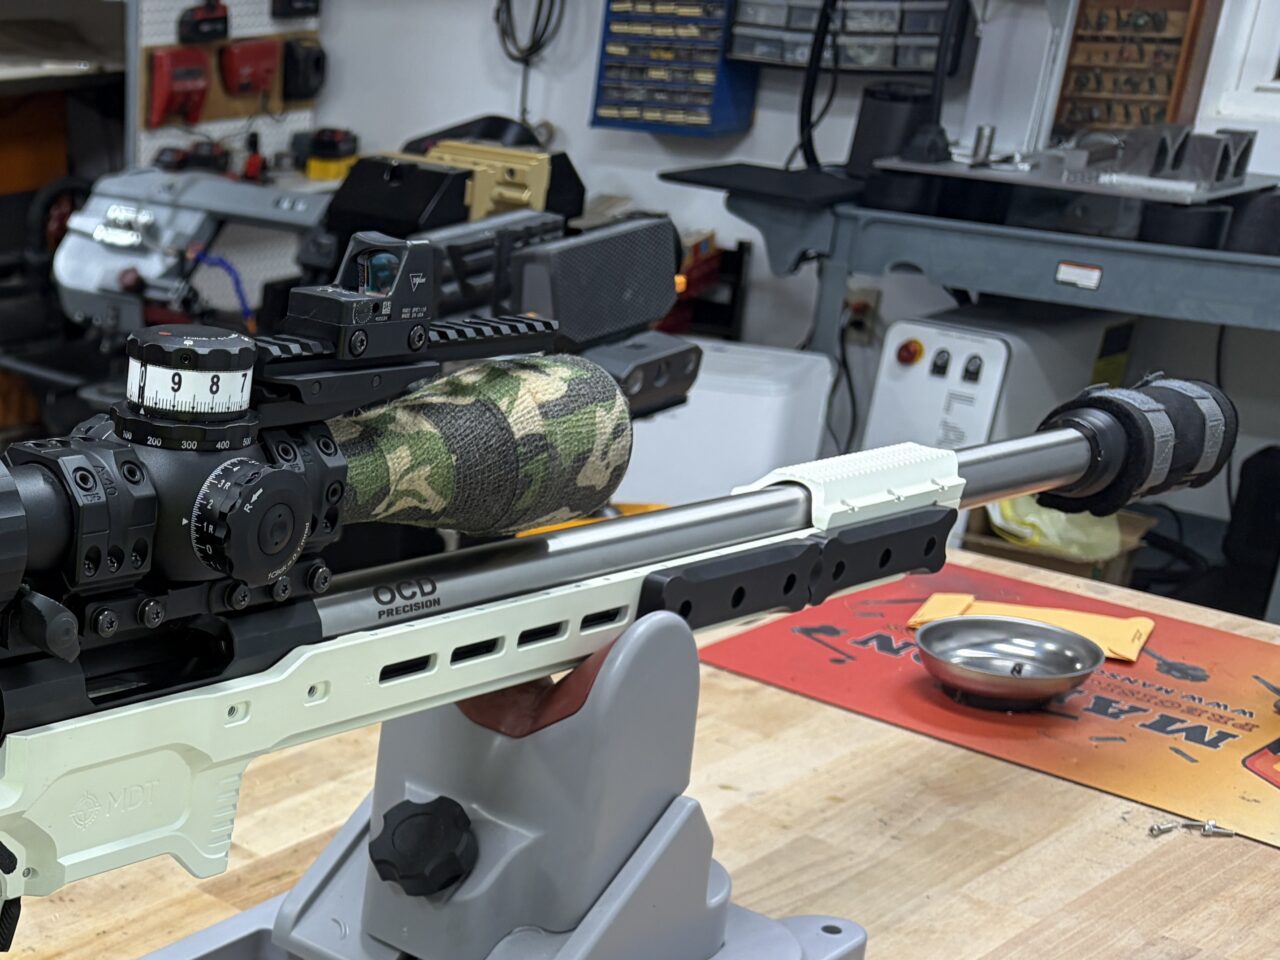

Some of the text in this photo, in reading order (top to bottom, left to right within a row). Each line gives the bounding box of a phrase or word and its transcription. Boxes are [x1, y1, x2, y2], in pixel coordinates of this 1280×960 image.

[171, 372, 182, 393] 9
[209, 374, 221, 395] 8
[240, 372, 248, 393] 7
[147, 436, 162, 446] 200
[181, 440, 198, 450] 300
[215, 440, 230, 449] 400
[206, 499, 214, 510] 2
[243, 503, 253, 513] R
[373, 577, 437, 606] OCD
[378, 597, 441, 620] PRECISION
[105, 779, 160, 818] MDT
